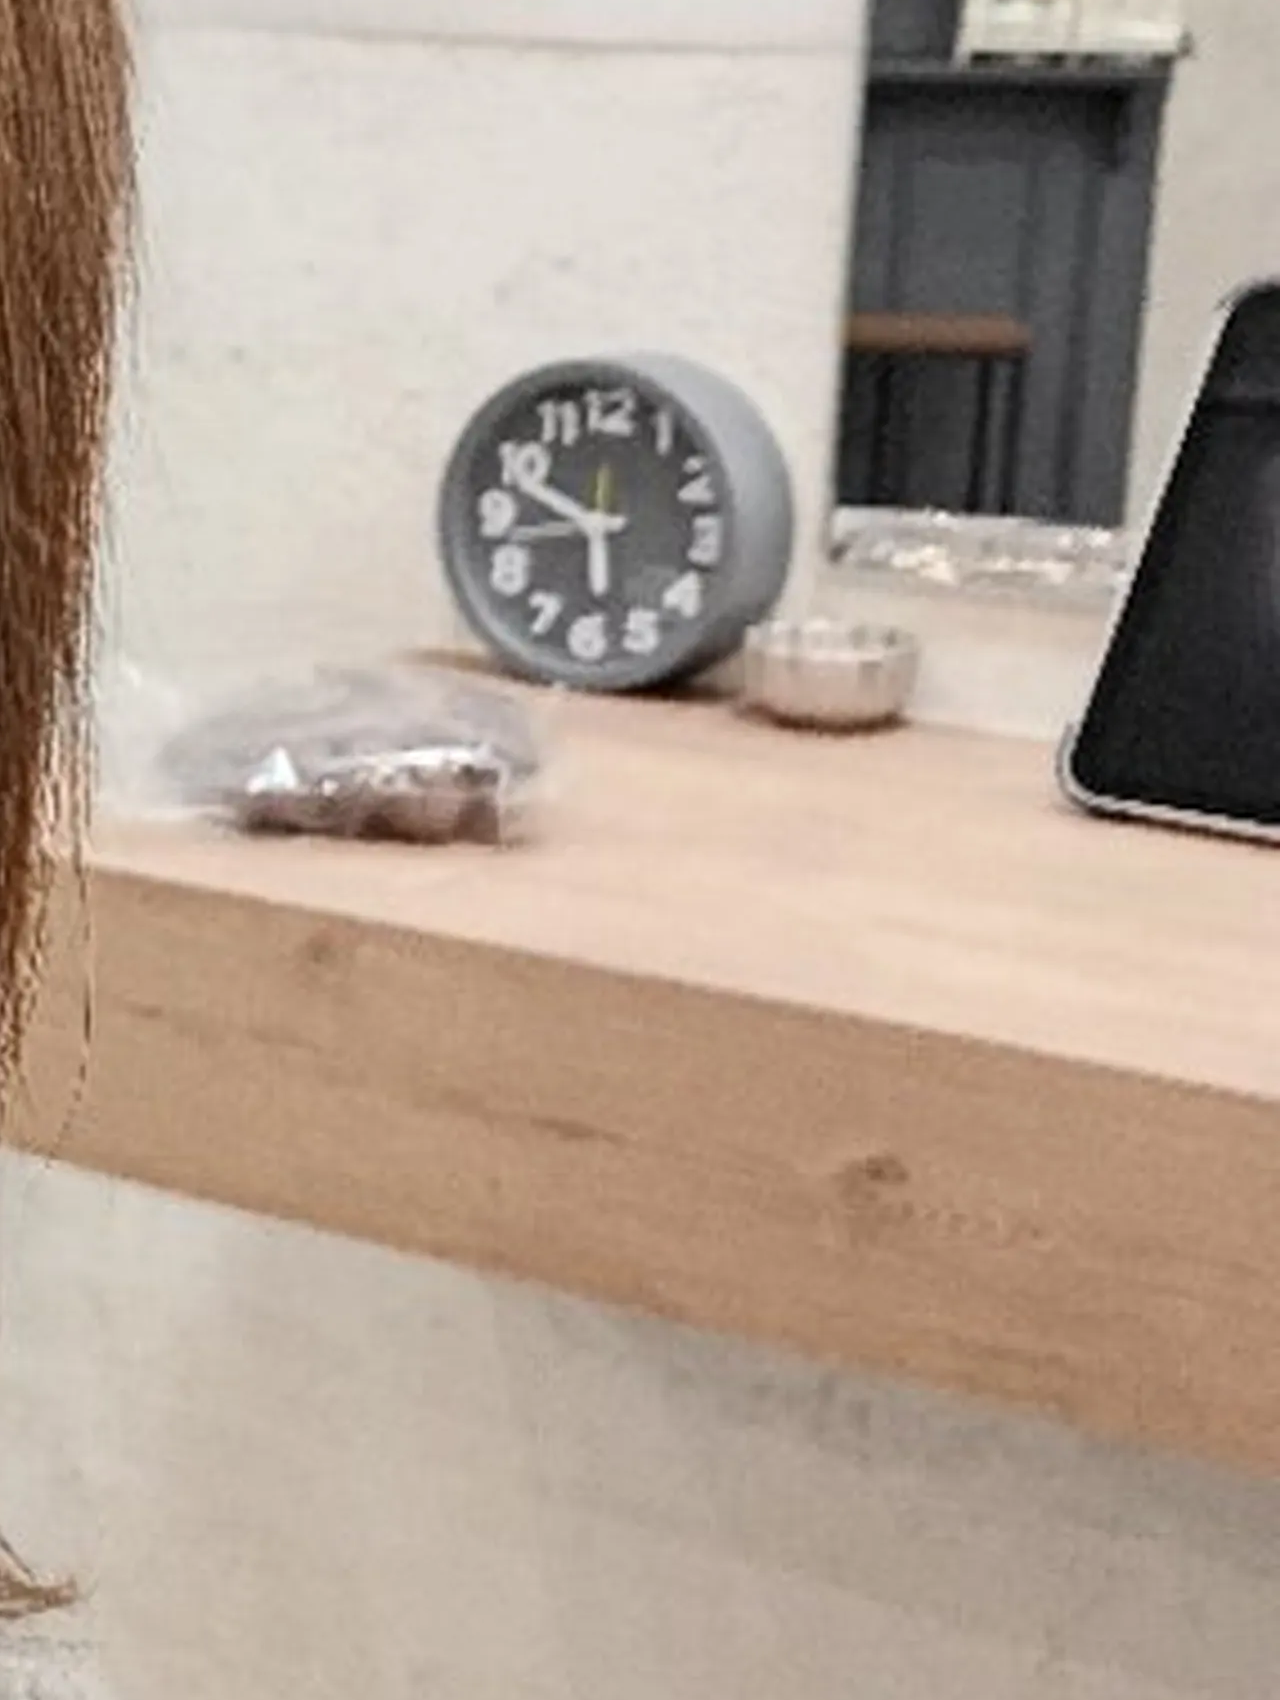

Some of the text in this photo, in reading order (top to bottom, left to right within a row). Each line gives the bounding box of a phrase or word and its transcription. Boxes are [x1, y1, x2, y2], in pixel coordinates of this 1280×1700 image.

[539, 400, 579, 446] 11
[586, 388, 636, 436] 12
[653, 411, 673, 454] 1
[498, 441, 551, 486] 10
[678, 456, 715, 504] 2
[478, 489, 516, 538] 9
[688, 515, 723, 565] 3
[492, 545, 529, 596] 8
[662, 570, 701, 618] 4
[529, 593, 563, 635] 7
[567, 615, 608, 660] 6
[622, 608, 660, 654] 5
